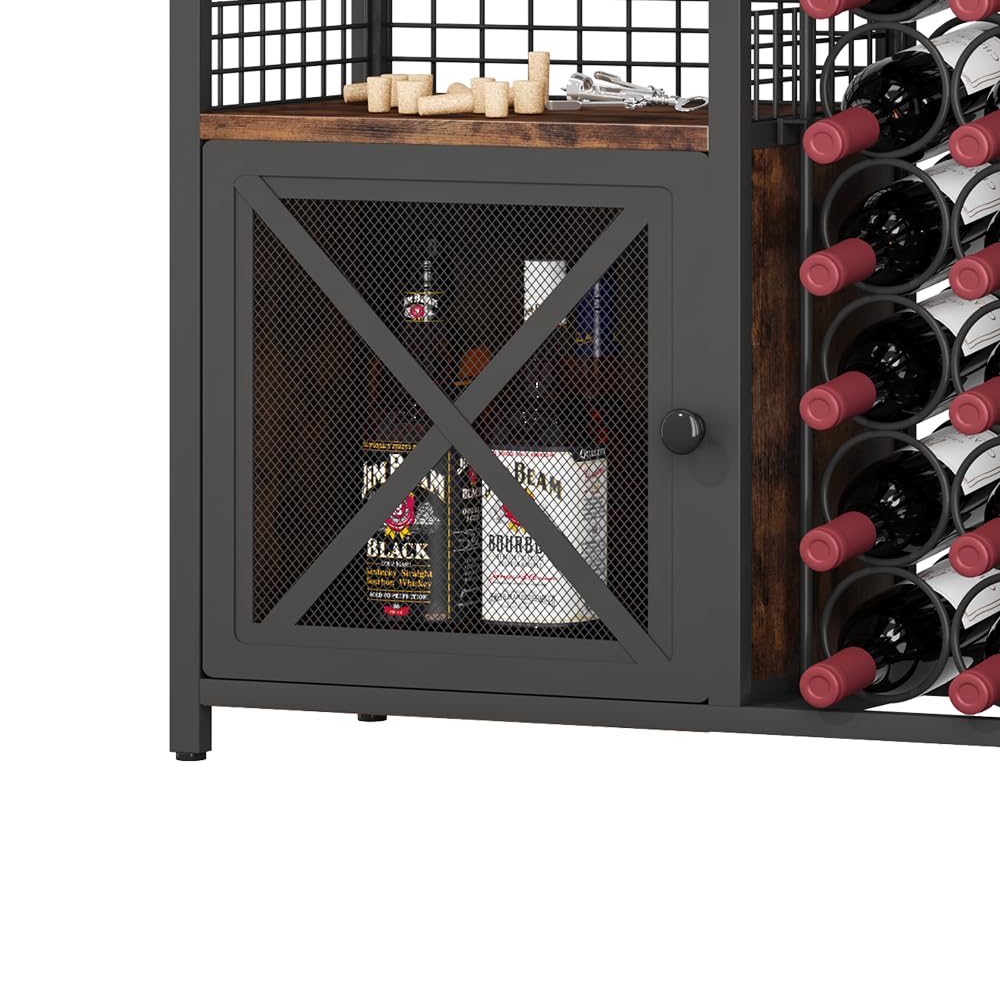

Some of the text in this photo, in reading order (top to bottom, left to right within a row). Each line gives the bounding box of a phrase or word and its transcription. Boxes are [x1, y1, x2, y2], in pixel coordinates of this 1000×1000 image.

[514, 461, 563, 502] BEAM
[366, 537, 431, 560] BLACK
[489, 535, 545, 554] BOURB
[401, 568, 433, 579] Straight
